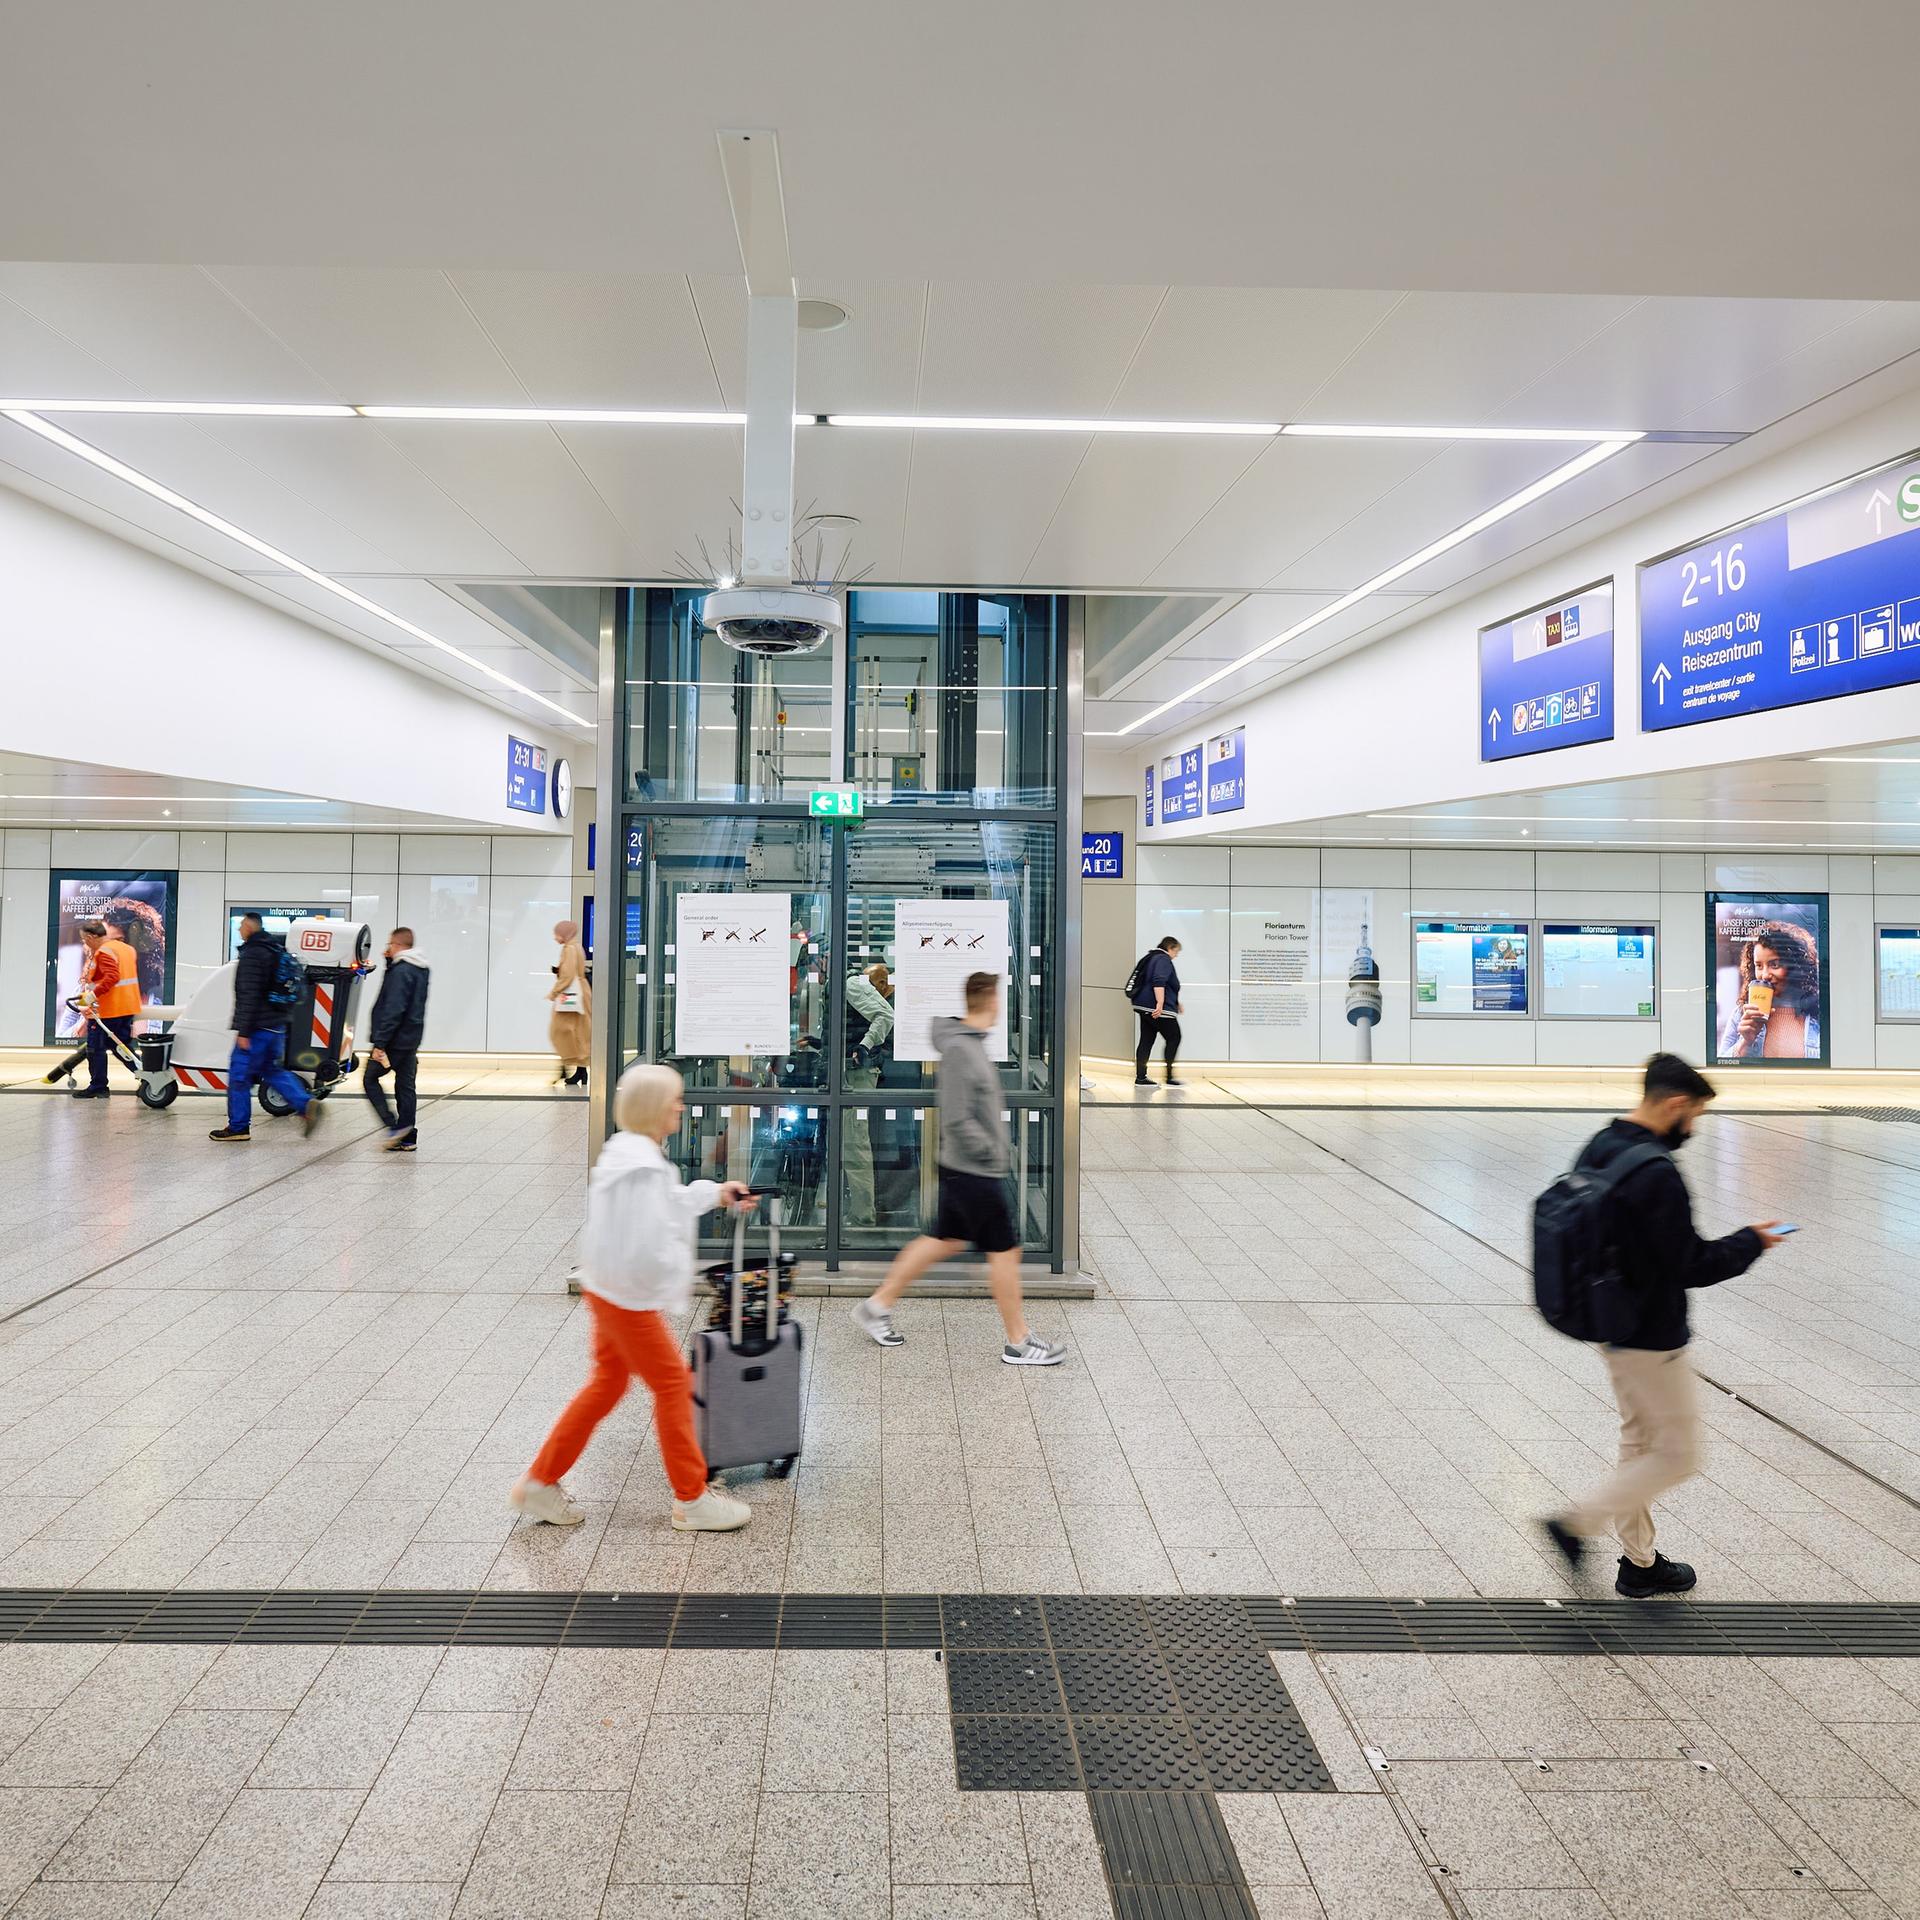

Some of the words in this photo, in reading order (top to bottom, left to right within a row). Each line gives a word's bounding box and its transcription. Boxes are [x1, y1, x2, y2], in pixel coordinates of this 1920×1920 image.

[1681, 543, 1746, 607] 2-16
[1547, 621, 1561, 636] TAXI
[1682, 620, 1733, 648] Ausgang
[1735, 610, 1761, 634] City
[1682, 640, 1763, 673] Reisezentrum
[1792, 653, 1815, 668] Polizei
[1736, 672, 1756, 686] sortie
[1708, 692, 1717, 704] de
[1717, 688, 1741, 703] voyage
[514, 744, 530, 768] 21-31
[1185, 753, 1198, 774] 2-16
[1095, 839, 1111, 854] 20
[1082, 858, 1092, 873] A
[67, 896, 88, 905] UNSER
[88, 896, 112, 905] BESTER
[62, 905, 86, 913] KAFFEE
[269, 908, 308, 916] Information
[1264, 922, 1306, 930] Florianturm
[1453, 923, 1491, 933] Information
[1580, 925, 1618, 934] Information
[1723, 918, 1743, 927] UNSER
[1744, 918, 1766, 927] BESTER
[1264, 933, 1288, 941] Florian
[1289, 933, 1309, 941] Tower
[1718, 927, 1741, 935] KAFFEE
[304, 932, 329, 949] DB
